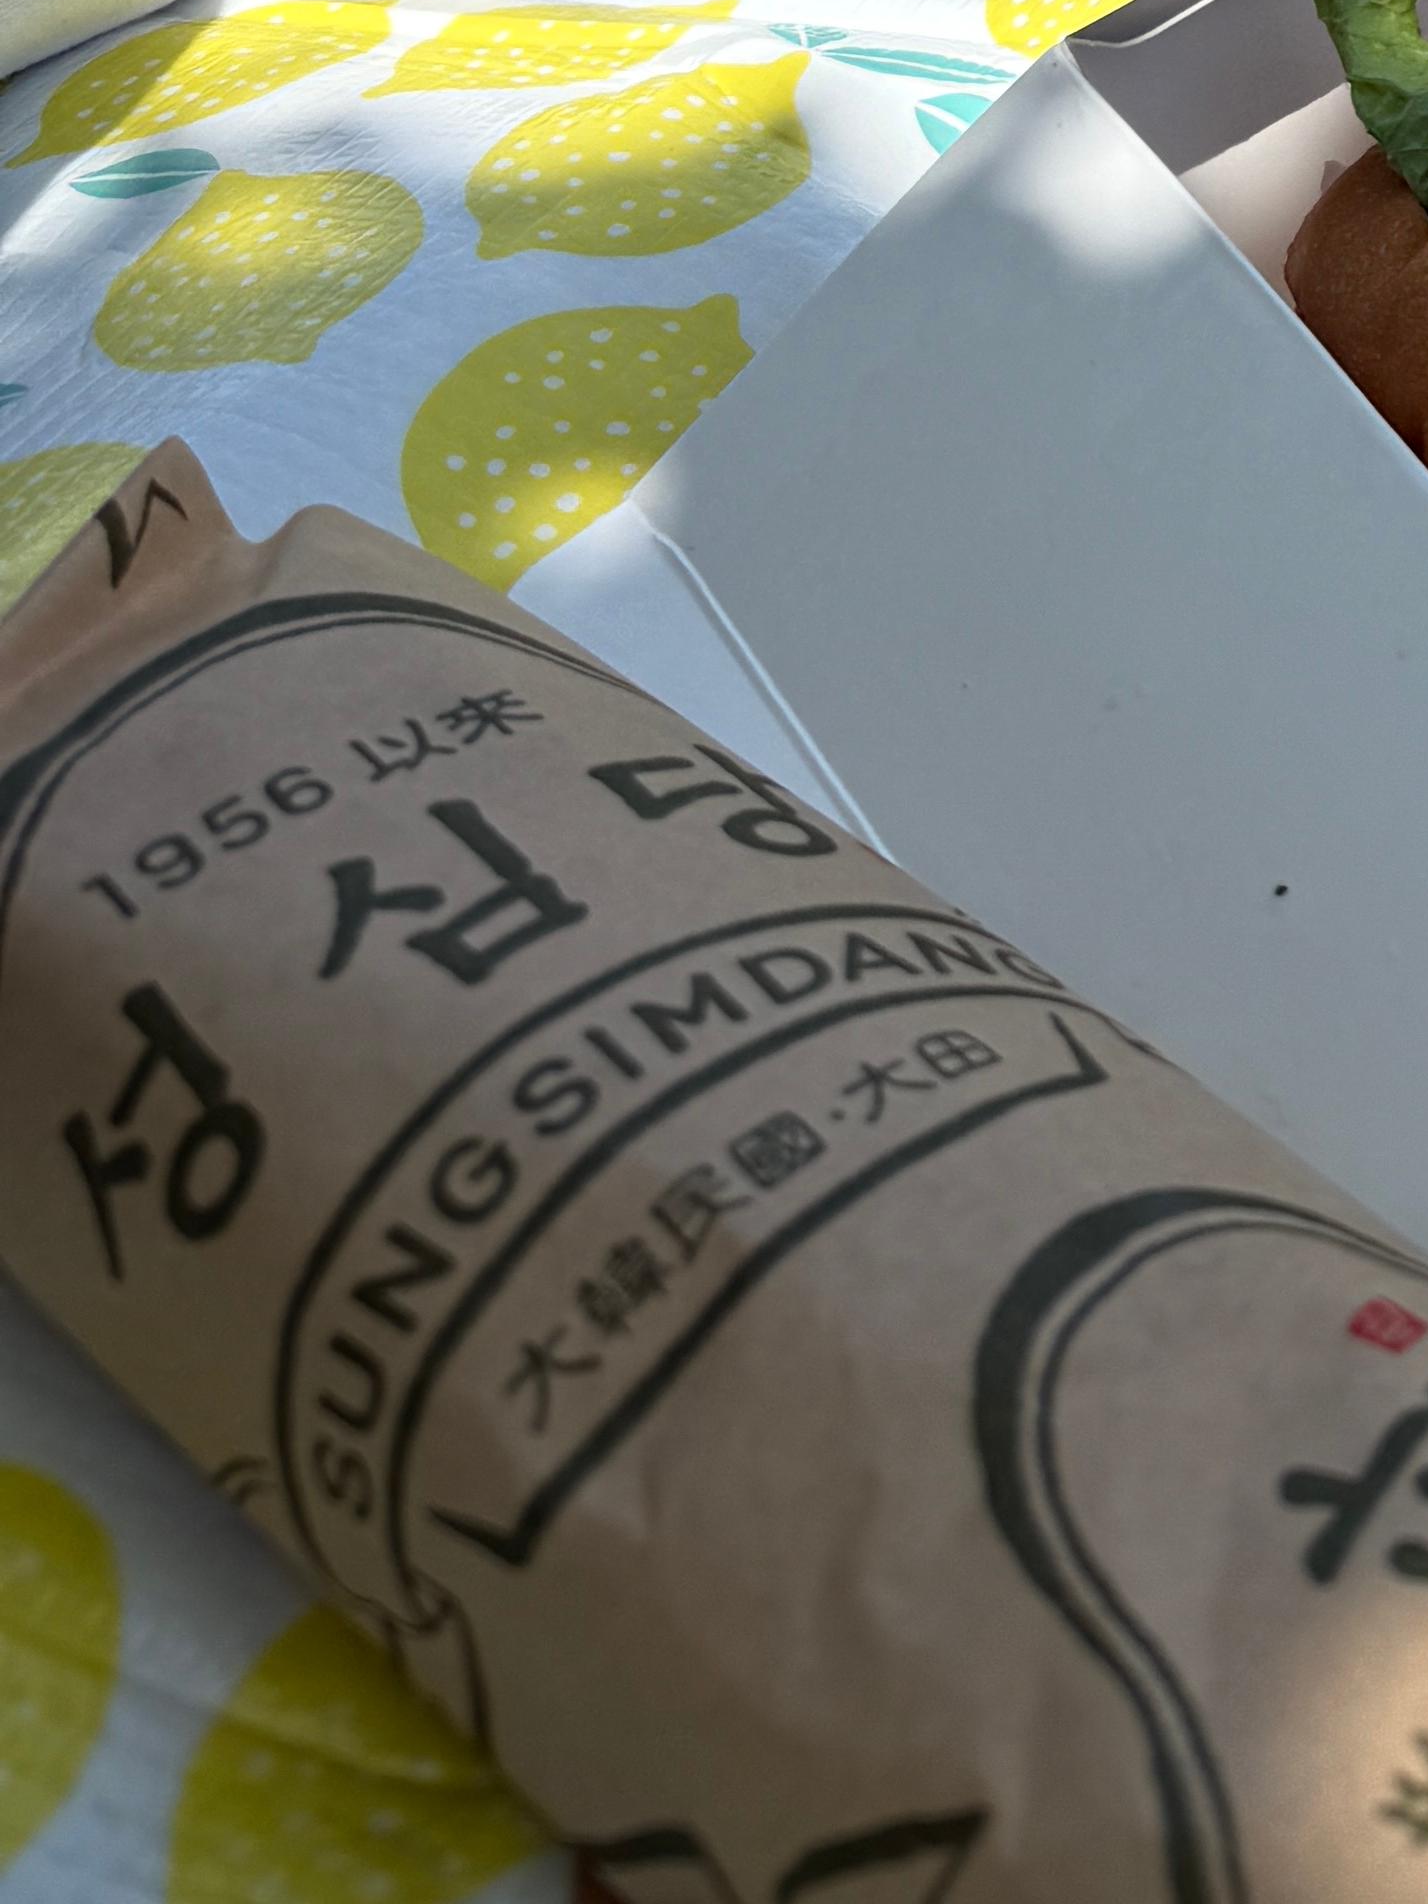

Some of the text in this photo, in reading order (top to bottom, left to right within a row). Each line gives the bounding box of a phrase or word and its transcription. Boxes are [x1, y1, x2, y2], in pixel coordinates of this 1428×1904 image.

[82, 686, 545, 922] 1956 以來
[61, 742, 841, 1283] 성심당
